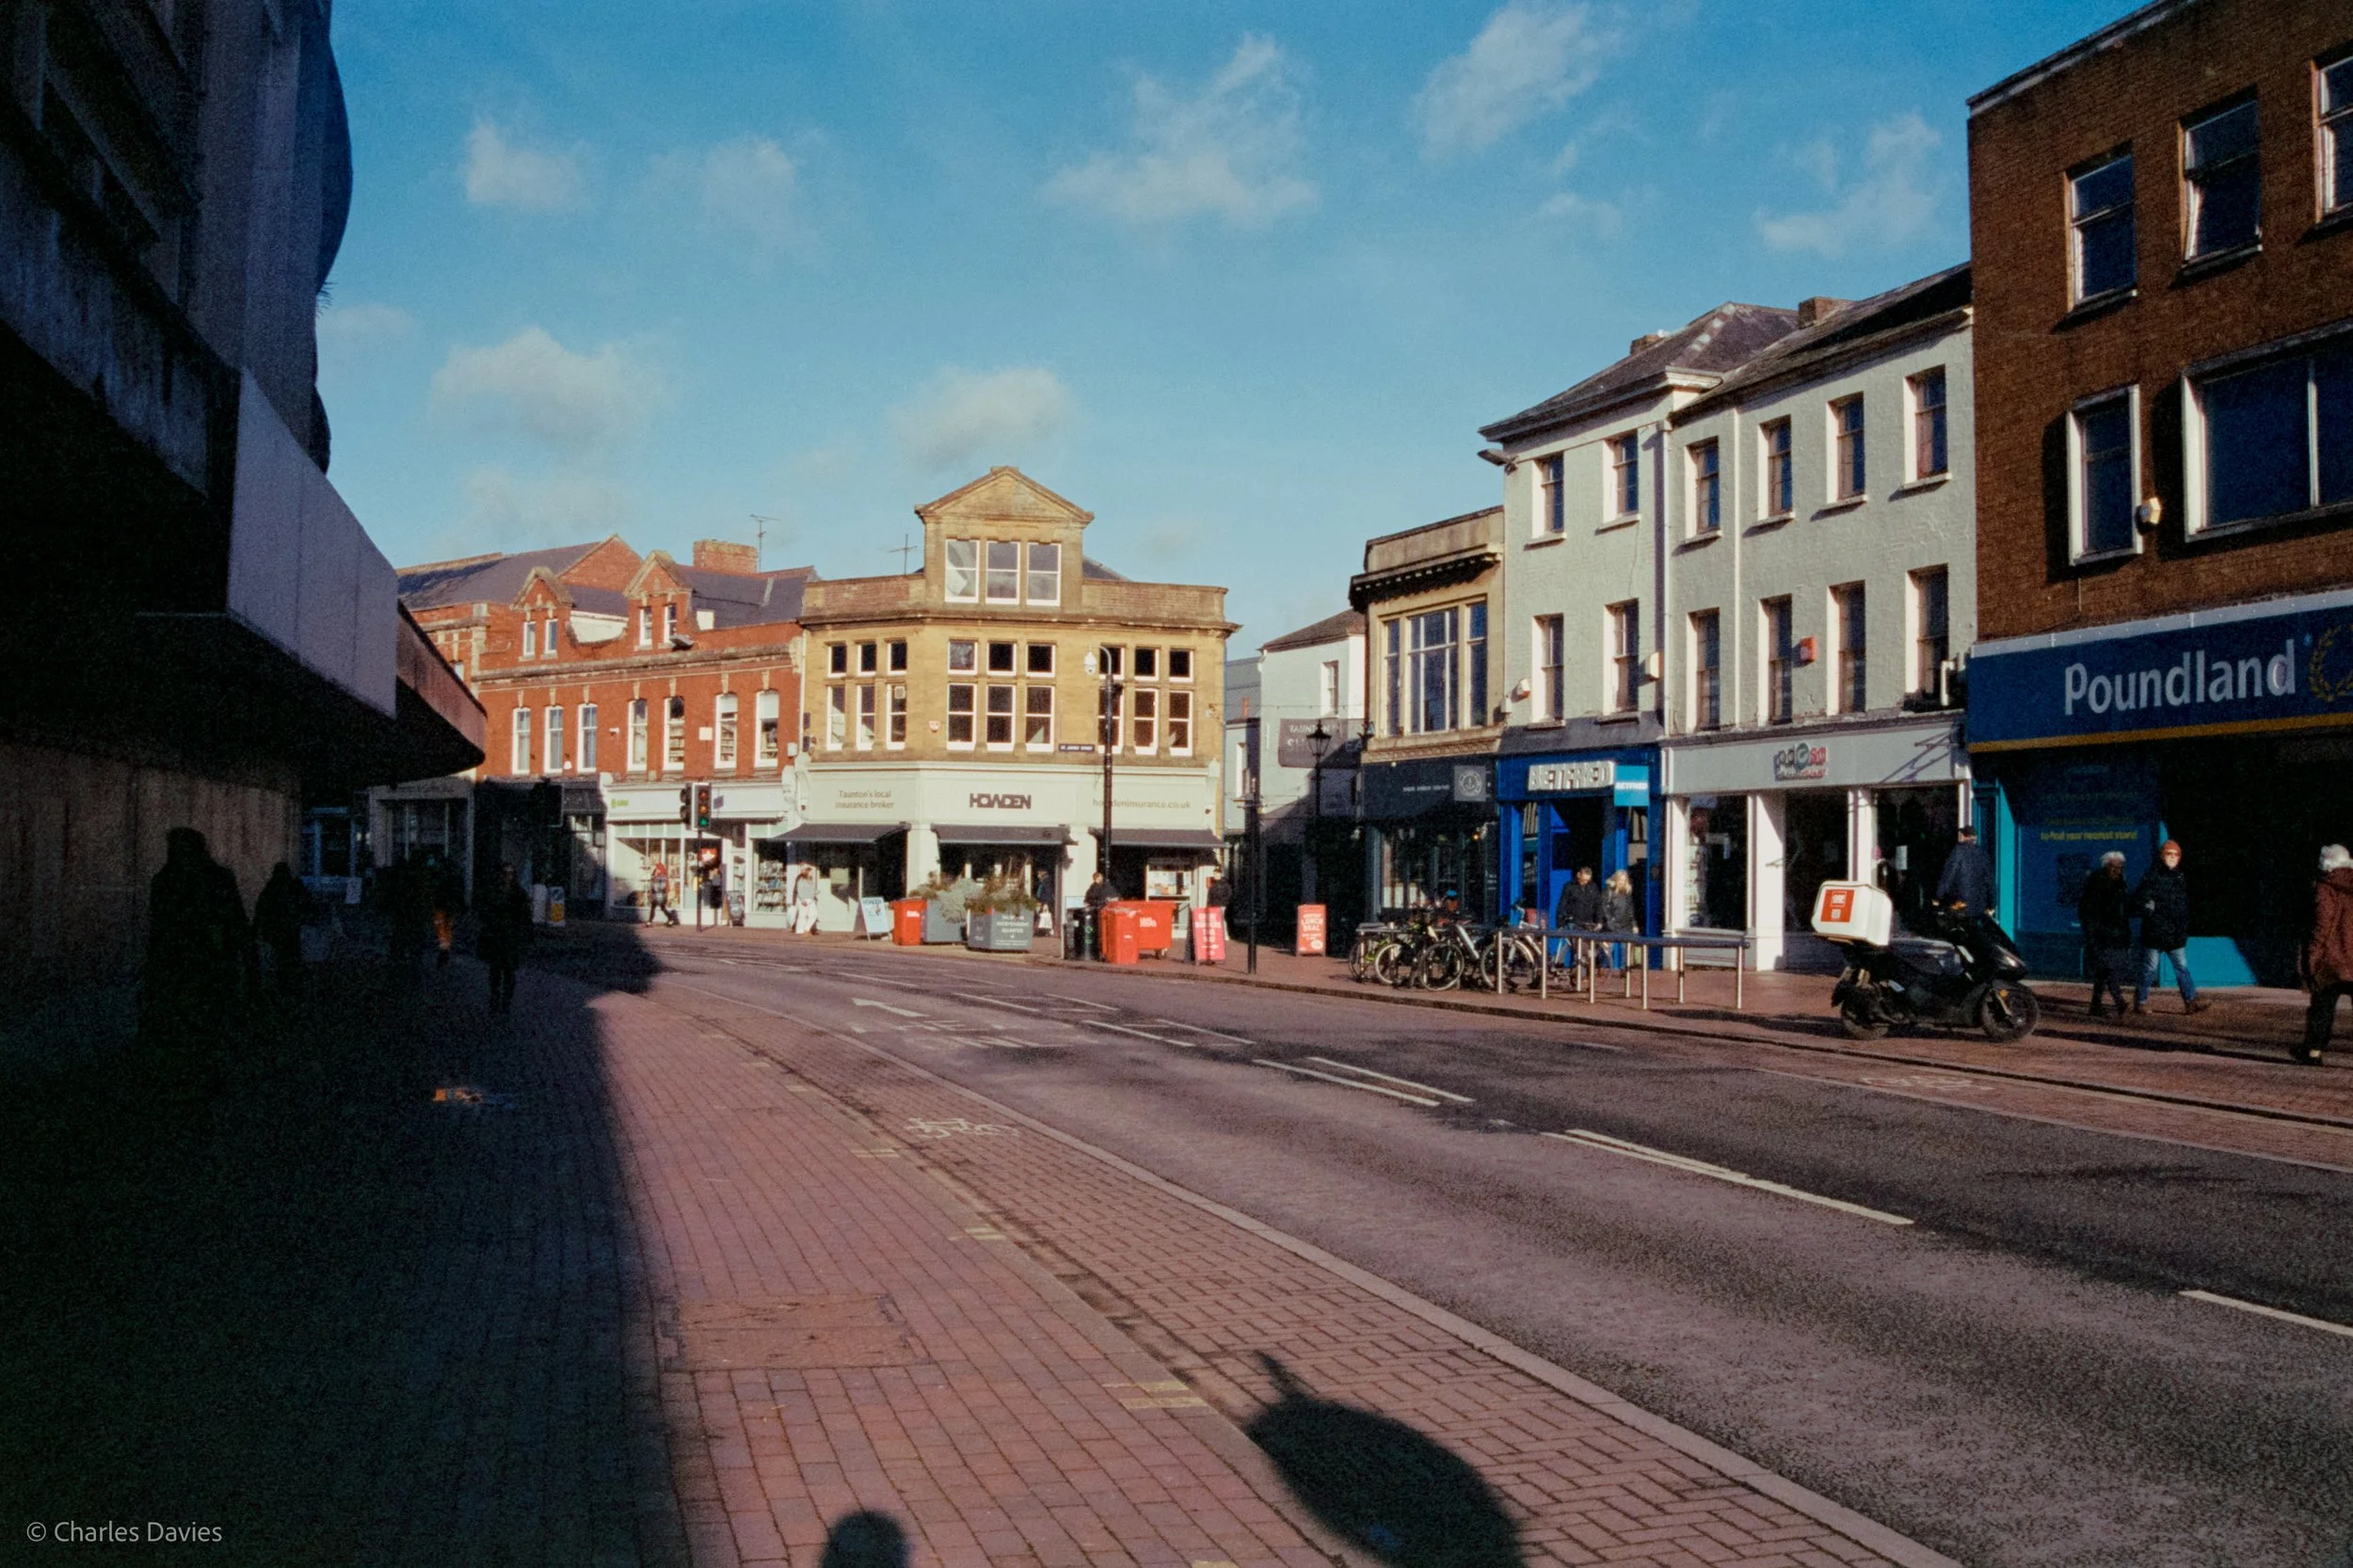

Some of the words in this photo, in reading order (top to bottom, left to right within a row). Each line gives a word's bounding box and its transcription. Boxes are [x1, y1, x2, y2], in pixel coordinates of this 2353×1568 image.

[2065, 639, 2297, 715] Poundland
[1528, 760, 1615, 791] BETFRED
[839, 790, 873, 798] Taunton's
[874, 790, 892, 798] local
[968, 792, 1032, 809] HOWDEN
[835, 801, 869, 809] insurance
[870, 800, 894, 809] broker
[1093, 797, 1192, 809] hodeninsurance.co.uk
